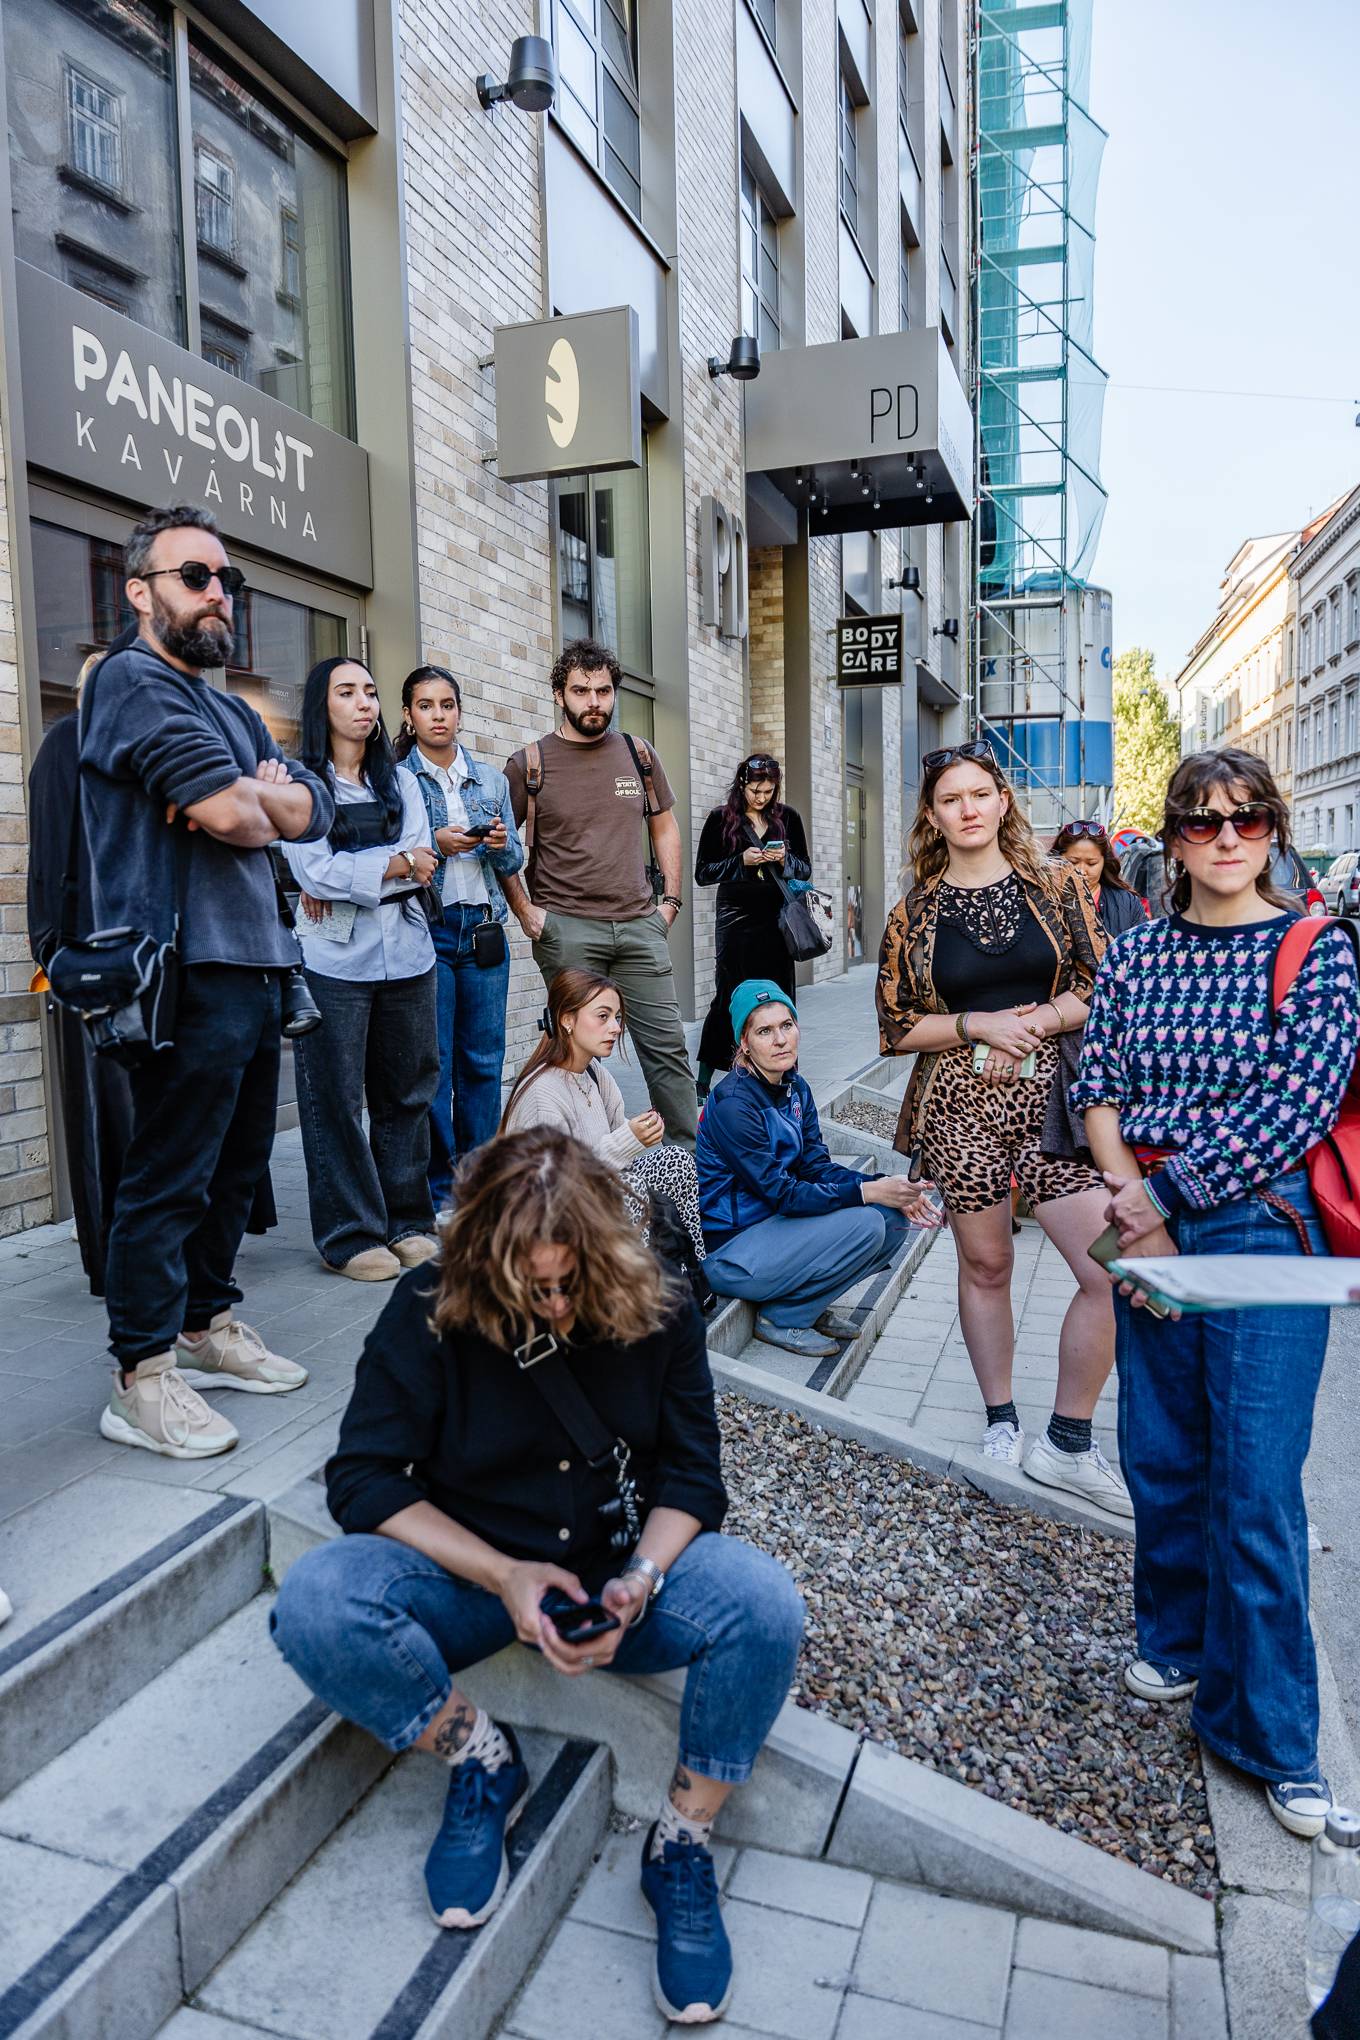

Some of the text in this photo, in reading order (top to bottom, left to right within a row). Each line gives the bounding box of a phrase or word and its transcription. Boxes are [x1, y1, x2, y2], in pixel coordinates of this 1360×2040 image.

[72, 324, 314, 492] PANEOLIT
[870, 384, 919, 444] PD
[75, 410, 317, 541] KAVÁRNA
[842, 627, 898, 648] BODY
[842, 651, 898, 672] CARE
